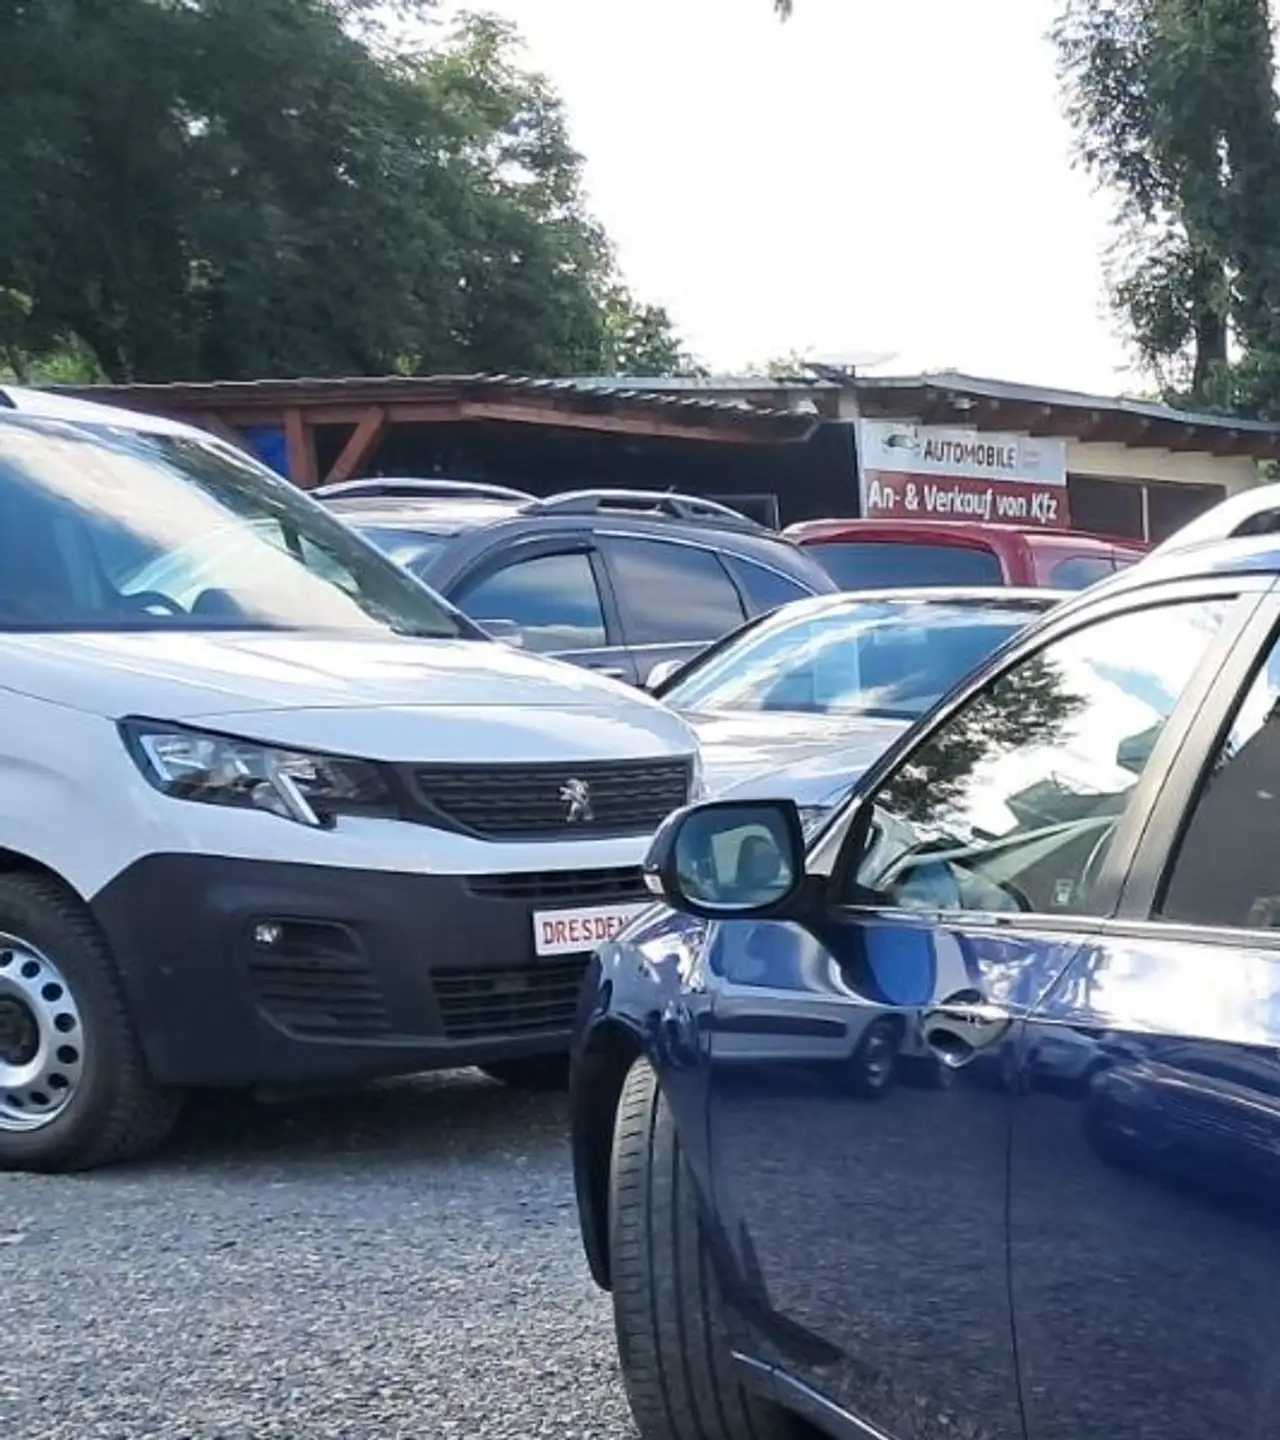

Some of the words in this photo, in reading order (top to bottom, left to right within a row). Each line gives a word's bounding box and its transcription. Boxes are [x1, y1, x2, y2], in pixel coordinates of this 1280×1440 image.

[923, 439, 1016, 469] AUTOMOBILE
[867, 480, 901, 509] An-
[904, 482, 920, 511] &
[924, 484, 993, 521] Verkauf
[996, 494, 1027, 519] von
[1030, 492, 1058, 525] Kfz
